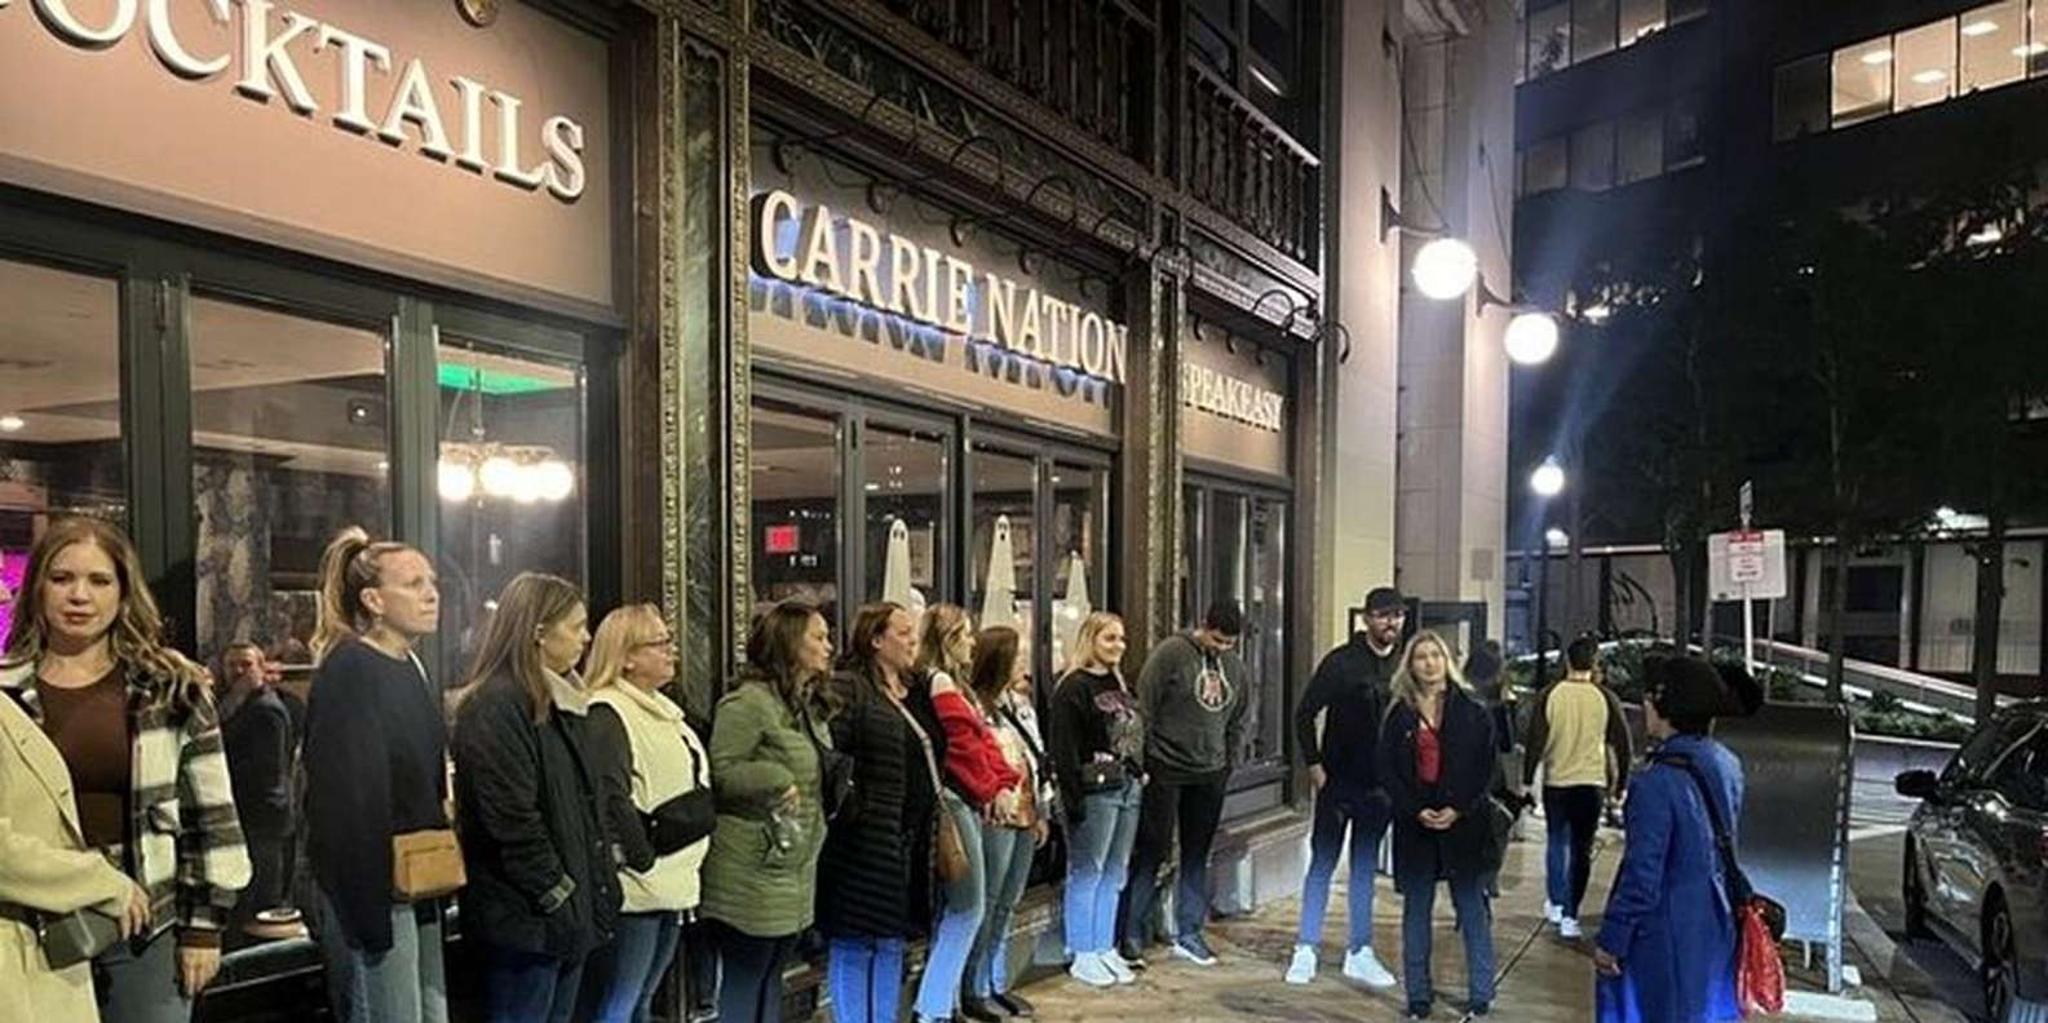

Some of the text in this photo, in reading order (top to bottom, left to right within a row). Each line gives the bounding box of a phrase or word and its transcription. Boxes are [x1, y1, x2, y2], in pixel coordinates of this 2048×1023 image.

[0, 0, 586, 201] OCKTAILS
[761, 189, 1129, 385] CARRIE NATION
